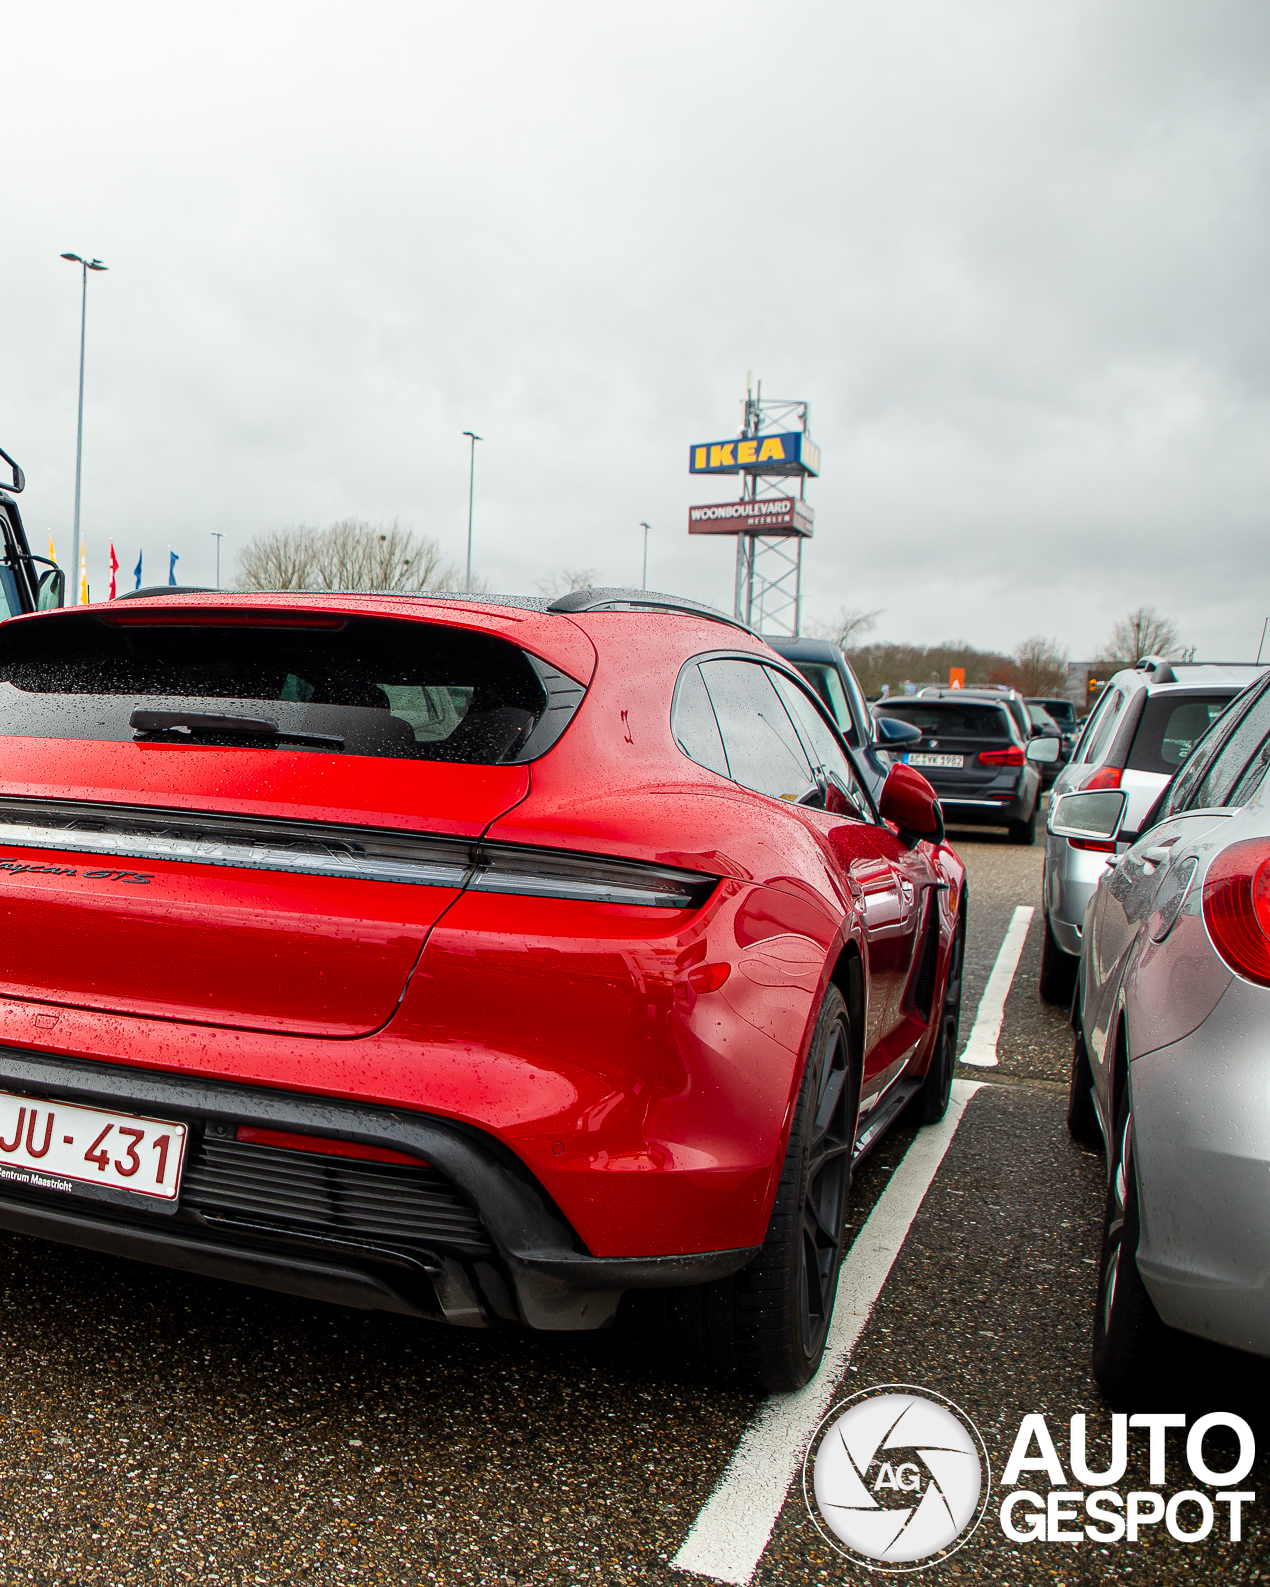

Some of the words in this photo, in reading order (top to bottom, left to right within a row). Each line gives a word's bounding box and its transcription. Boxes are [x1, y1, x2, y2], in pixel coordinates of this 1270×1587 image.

[695, 437, 785, 469] IKEA
[691, 501, 791, 521] WOONBOULEVARD
[747, 515, 791, 525] HEERLEN
[82, 870, 155, 884] GTS
[30, 1174, 72, 1192] Maastricht
